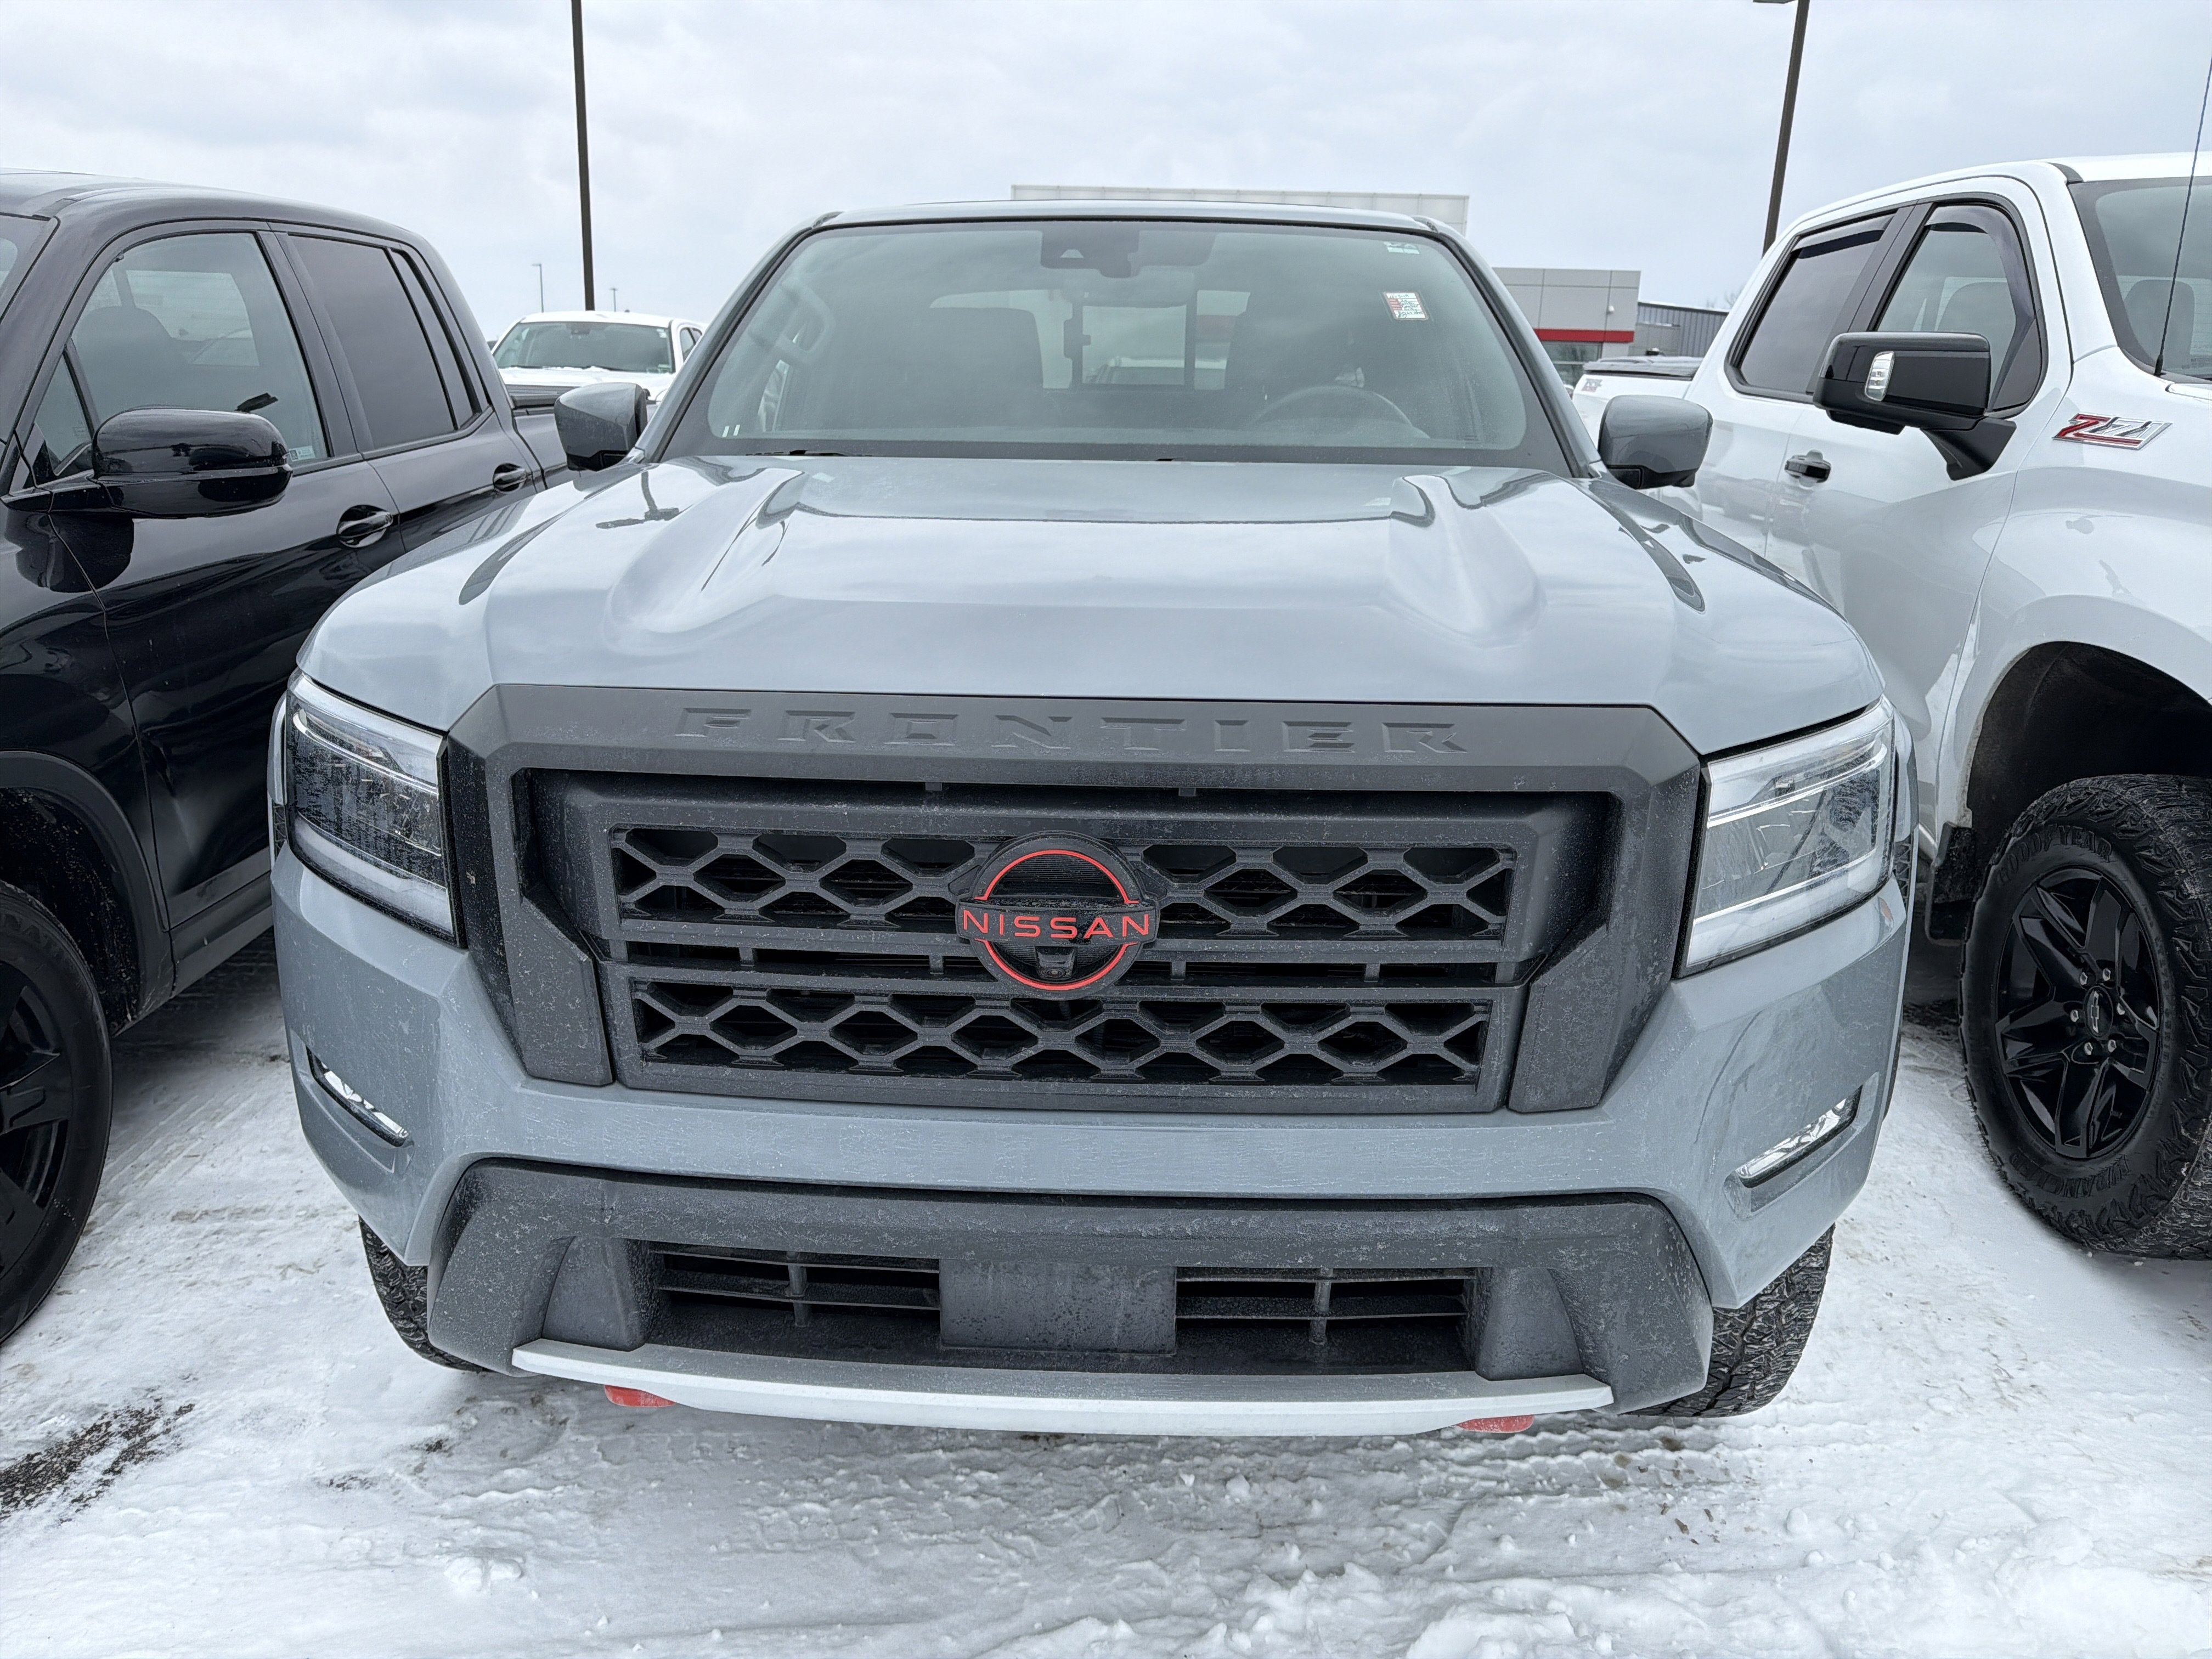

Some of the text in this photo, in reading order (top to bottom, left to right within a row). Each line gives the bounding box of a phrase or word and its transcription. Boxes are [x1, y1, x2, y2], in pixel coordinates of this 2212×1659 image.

[2052, 413, 2172, 450] Z71
[674, 707, 1468, 754] FRONTIER
[962, 909, 1150, 940] NISSAN
